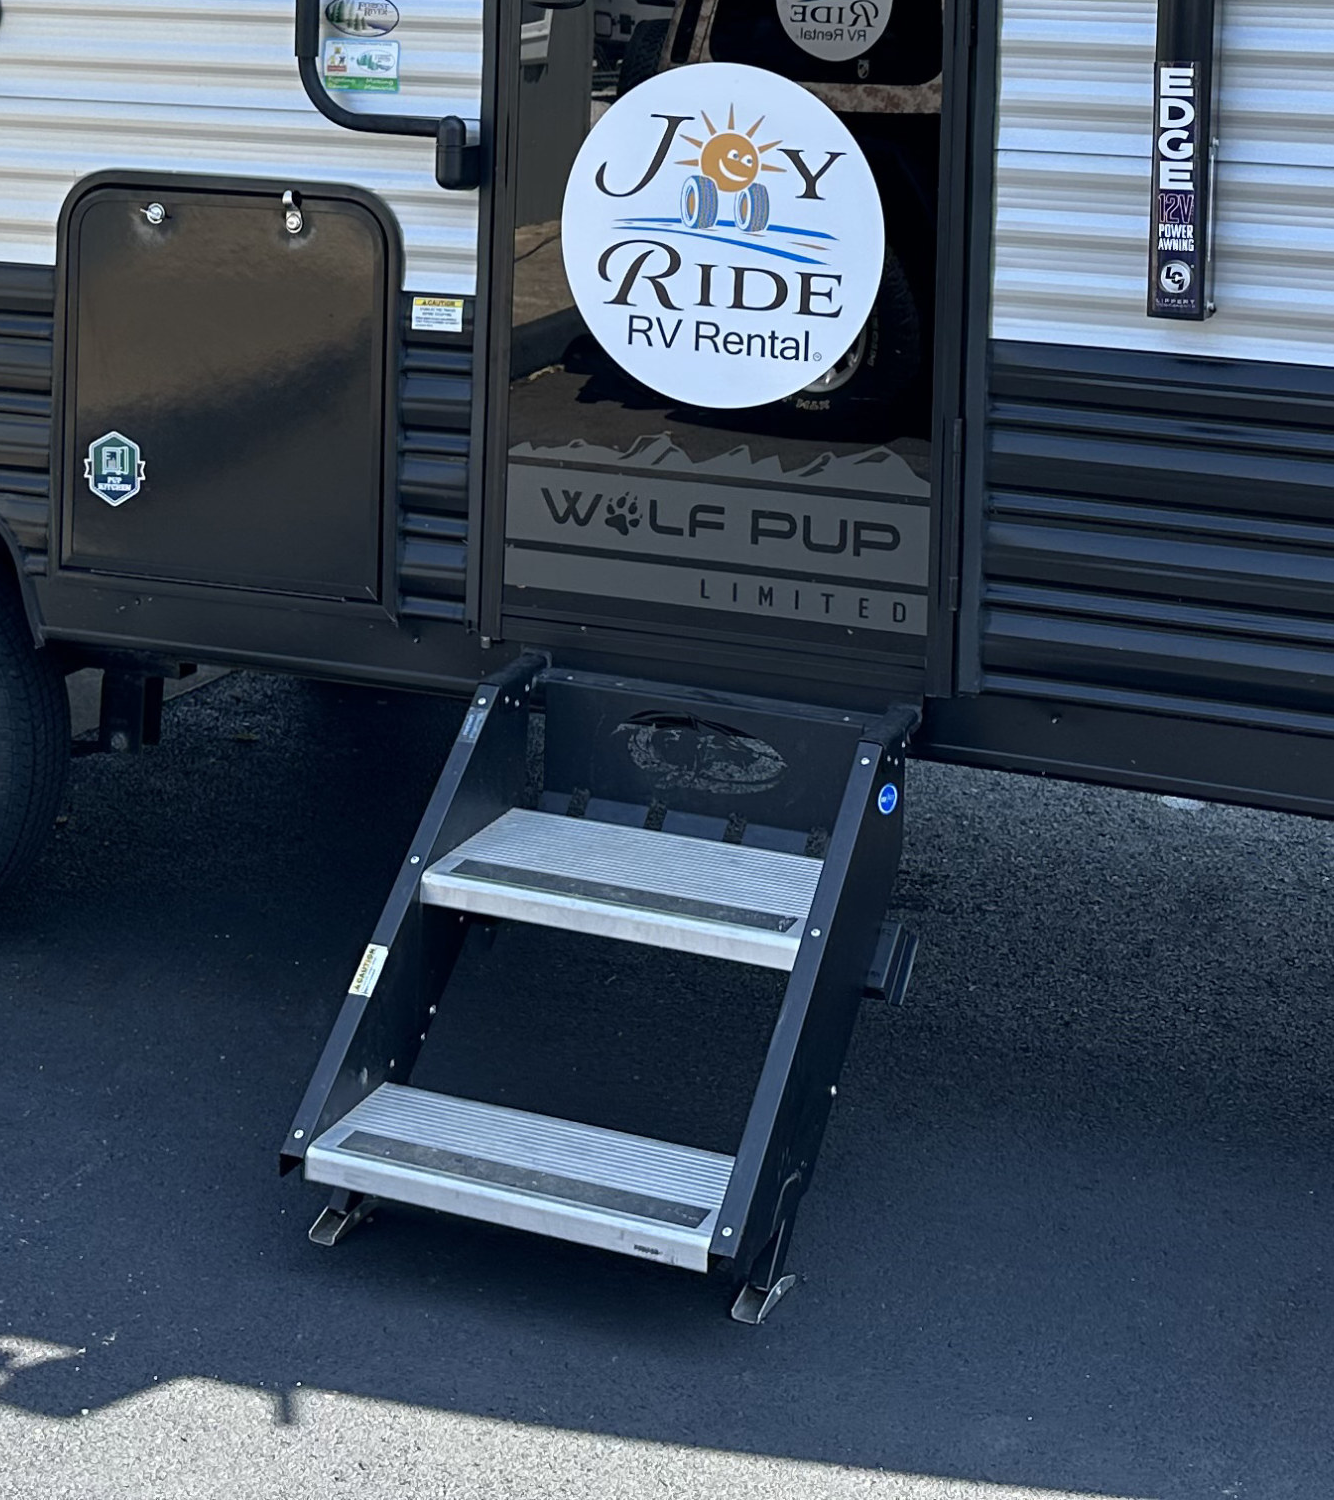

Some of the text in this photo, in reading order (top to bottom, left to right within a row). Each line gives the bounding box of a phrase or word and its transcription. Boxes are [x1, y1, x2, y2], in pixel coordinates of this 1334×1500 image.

[1158, 67, 1195, 191] EDGE
[1158, 193, 1195, 224] 12V
[1158, 223, 1194, 238] POWER
[1157, 238, 1195, 251] AWNING
[597, 239, 844, 318] RIDE
[628, 314, 810, 362] RV Rental
[750, 509, 901, 557] PUP
[700, 578, 906, 623] LIMITED
